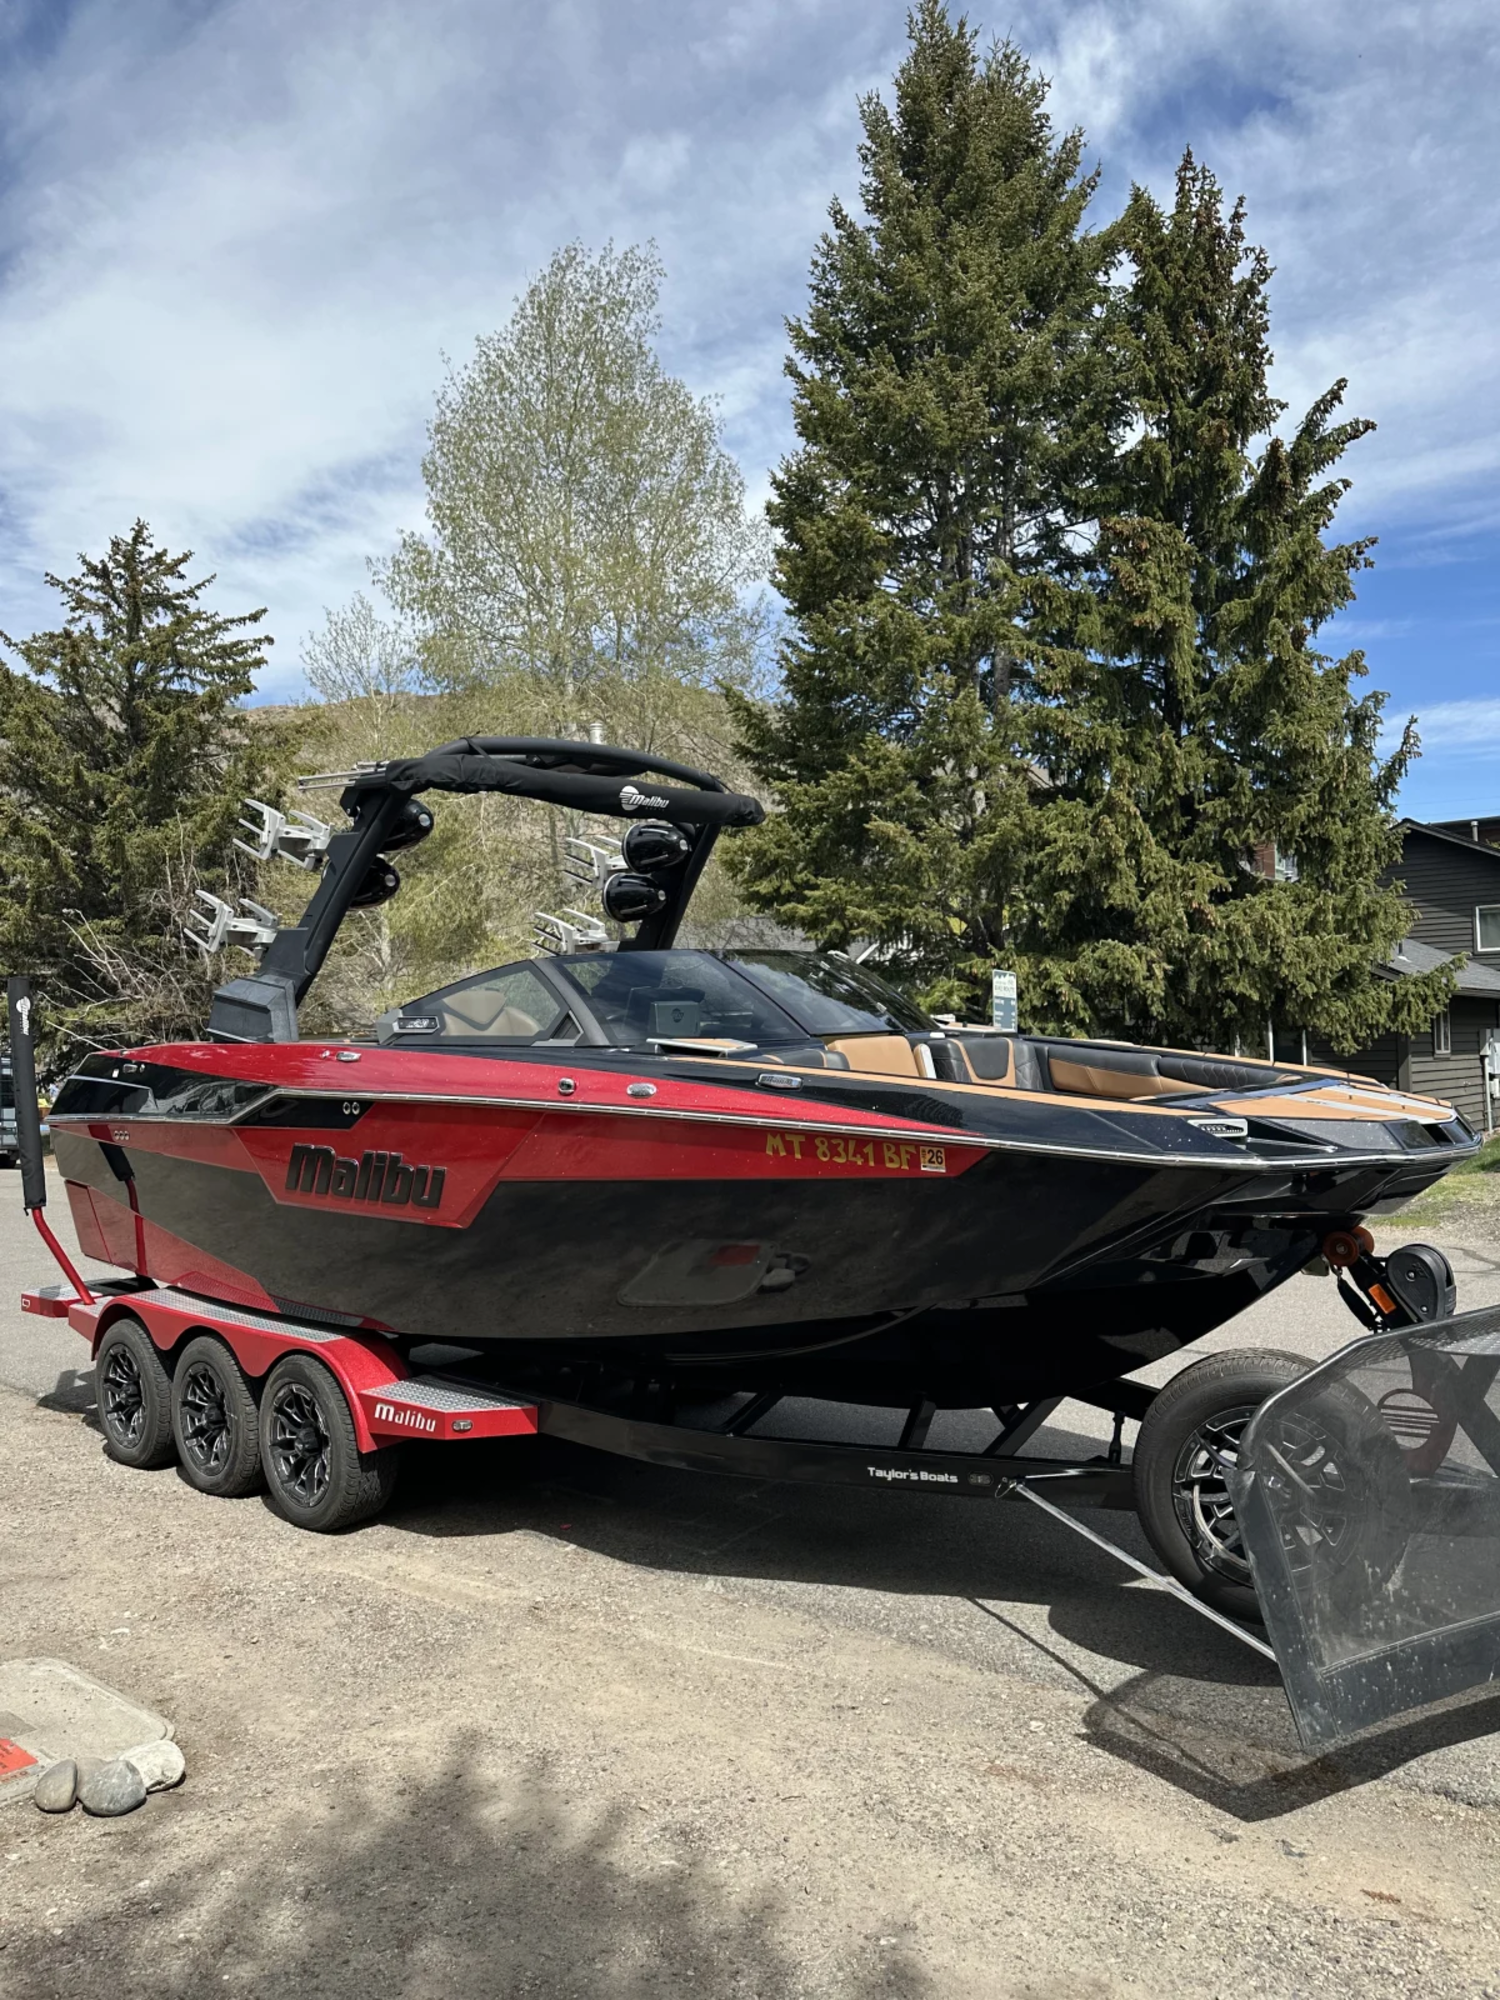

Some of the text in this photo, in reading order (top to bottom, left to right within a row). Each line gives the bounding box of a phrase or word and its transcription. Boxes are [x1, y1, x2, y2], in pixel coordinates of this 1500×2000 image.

[765, 1132, 806, 1160] MT
[814, 1136, 875, 1167] 8341
[882, 1142, 917, 1170] BF
[927, 1148, 944, 1165] 26
[285, 1142, 448, 1209] Malibu
[374, 1402, 437, 1433] Malibu
[867, 1466, 959, 1483] Taylor's Boats
